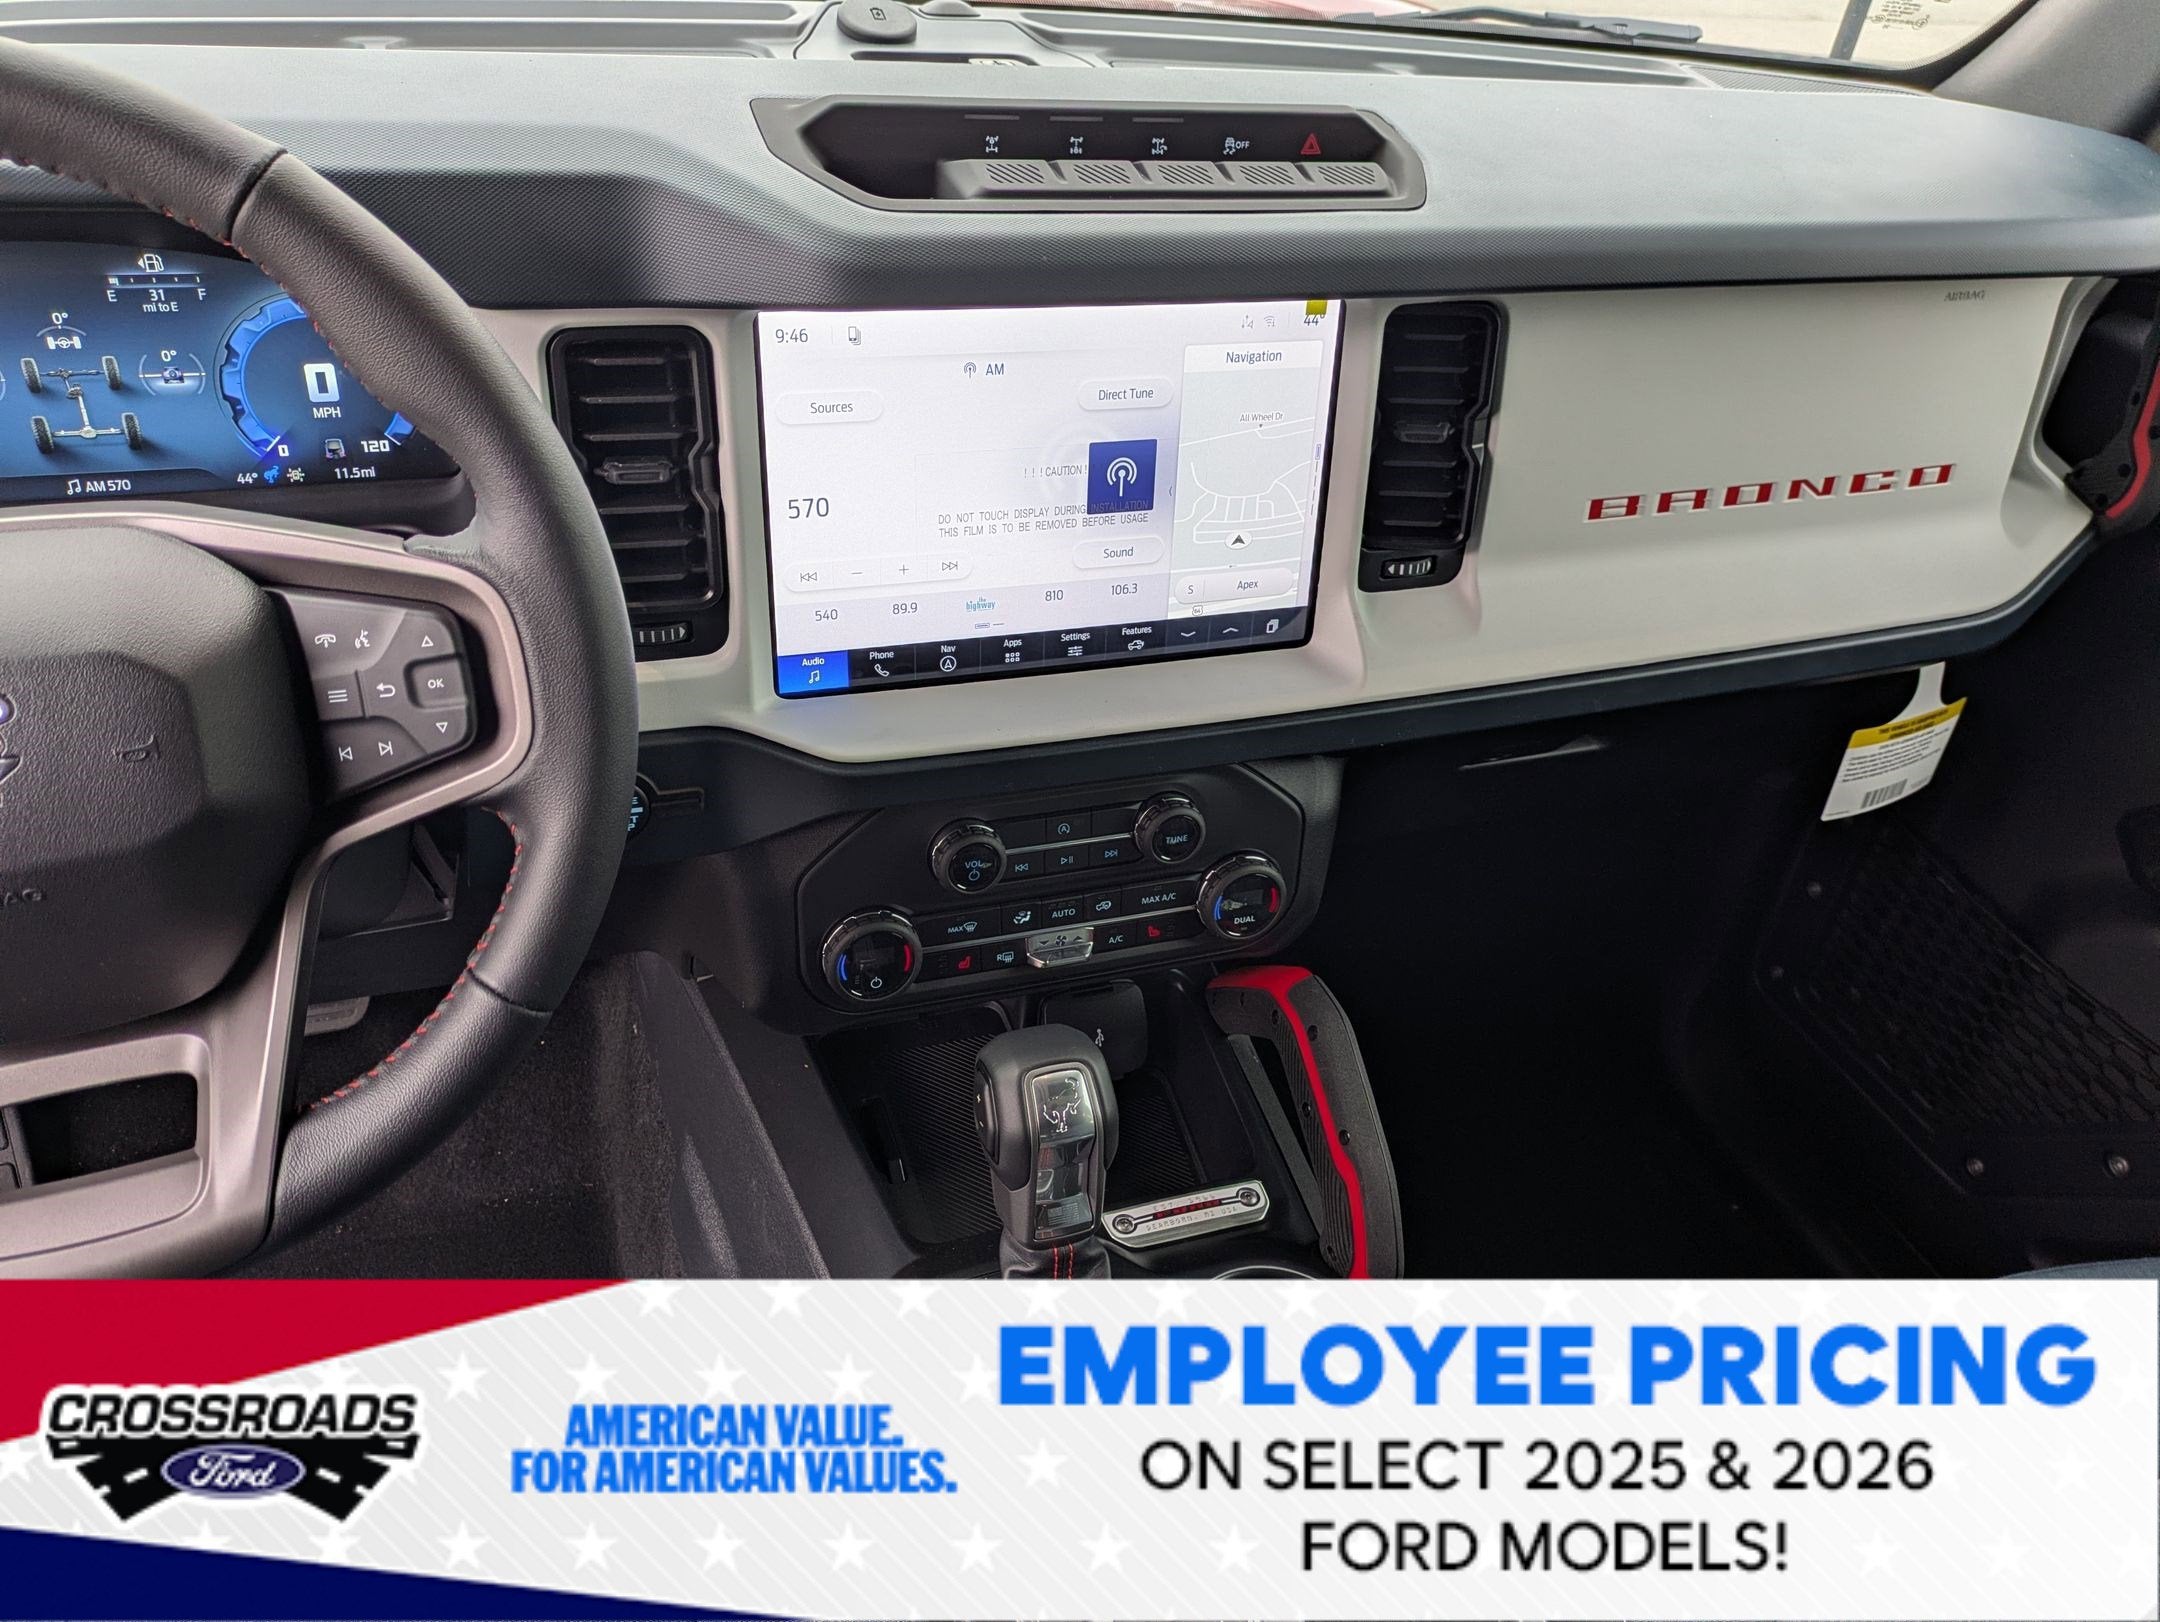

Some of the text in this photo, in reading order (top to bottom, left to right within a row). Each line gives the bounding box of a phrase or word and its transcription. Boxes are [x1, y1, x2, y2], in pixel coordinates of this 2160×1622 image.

[1235, 140, 1250, 150] OFF
[107, 289, 117, 302] E
[149, 289, 165, 301] 31
[198, 288, 207, 301] F
[142, 301, 179, 312] mi to E
[51, 312, 68, 325] 0°
[775, 328, 809, 344] 9:46
[160, 350, 178, 362] 0°
[1225, 350, 1283, 365] Navigation
[985, 363, 1005, 376] AM
[303, 363, 340, 402] 0
[1098, 387, 1154, 401] Direct Tune
[313, 407, 341, 419] MPH
[810, 402, 854, 415] Sources
[1251, 413, 1273, 422] Wheel
[1275, 412, 1284, 421] Dr
[278, 445, 290, 457] 0
[360, 440, 391, 453] 120
[237, 472, 258, 485] 44°
[334, 467, 376, 480] 11.5mi
[86, 480, 132, 493] AM 570
[1584, 463, 1956, 522] BRONCO
[787, 498, 831, 520] 570
[938, 499, 1149, 525] DO NOT TOUCH DISPLAY DURING INSTALLATION
[939, 512, 1149, 538] THIS FILM IS TO BE REMOVED BEFORE USAGE
[1103, 547, 1134, 559] Sound
[1110, 583, 1138, 596] 106.3
[1187, 585, 1194, 595] S
[1237, 580, 1259, 591] Apex
[1044, 589, 1064, 602] 810
[892, 602, 918, 616] 89.9
[965, 600, 996, 612] highway
[814, 608, 838, 622] 540
[1061, 631, 1090, 643] Settings
[1121, 626, 1152, 636] Features
[940, 644, 956, 654] Nav
[1003, 638, 1023, 649] Apps
[869, 649, 894, 661] Phone
[801, 656, 825, 667] Audio
[428, 678, 444, 689] OK
[1165, 834, 1188, 845] TUNE
[965, 860, 984, 870] VOL
[1141, 892, 1176, 905] MAX A/C
[1051, 908, 1076, 919] AUTO
[1233, 916, 1256, 925] DUAL
[948, 924, 964, 934] MAX
[1109, 934, 1124, 944] A/C
